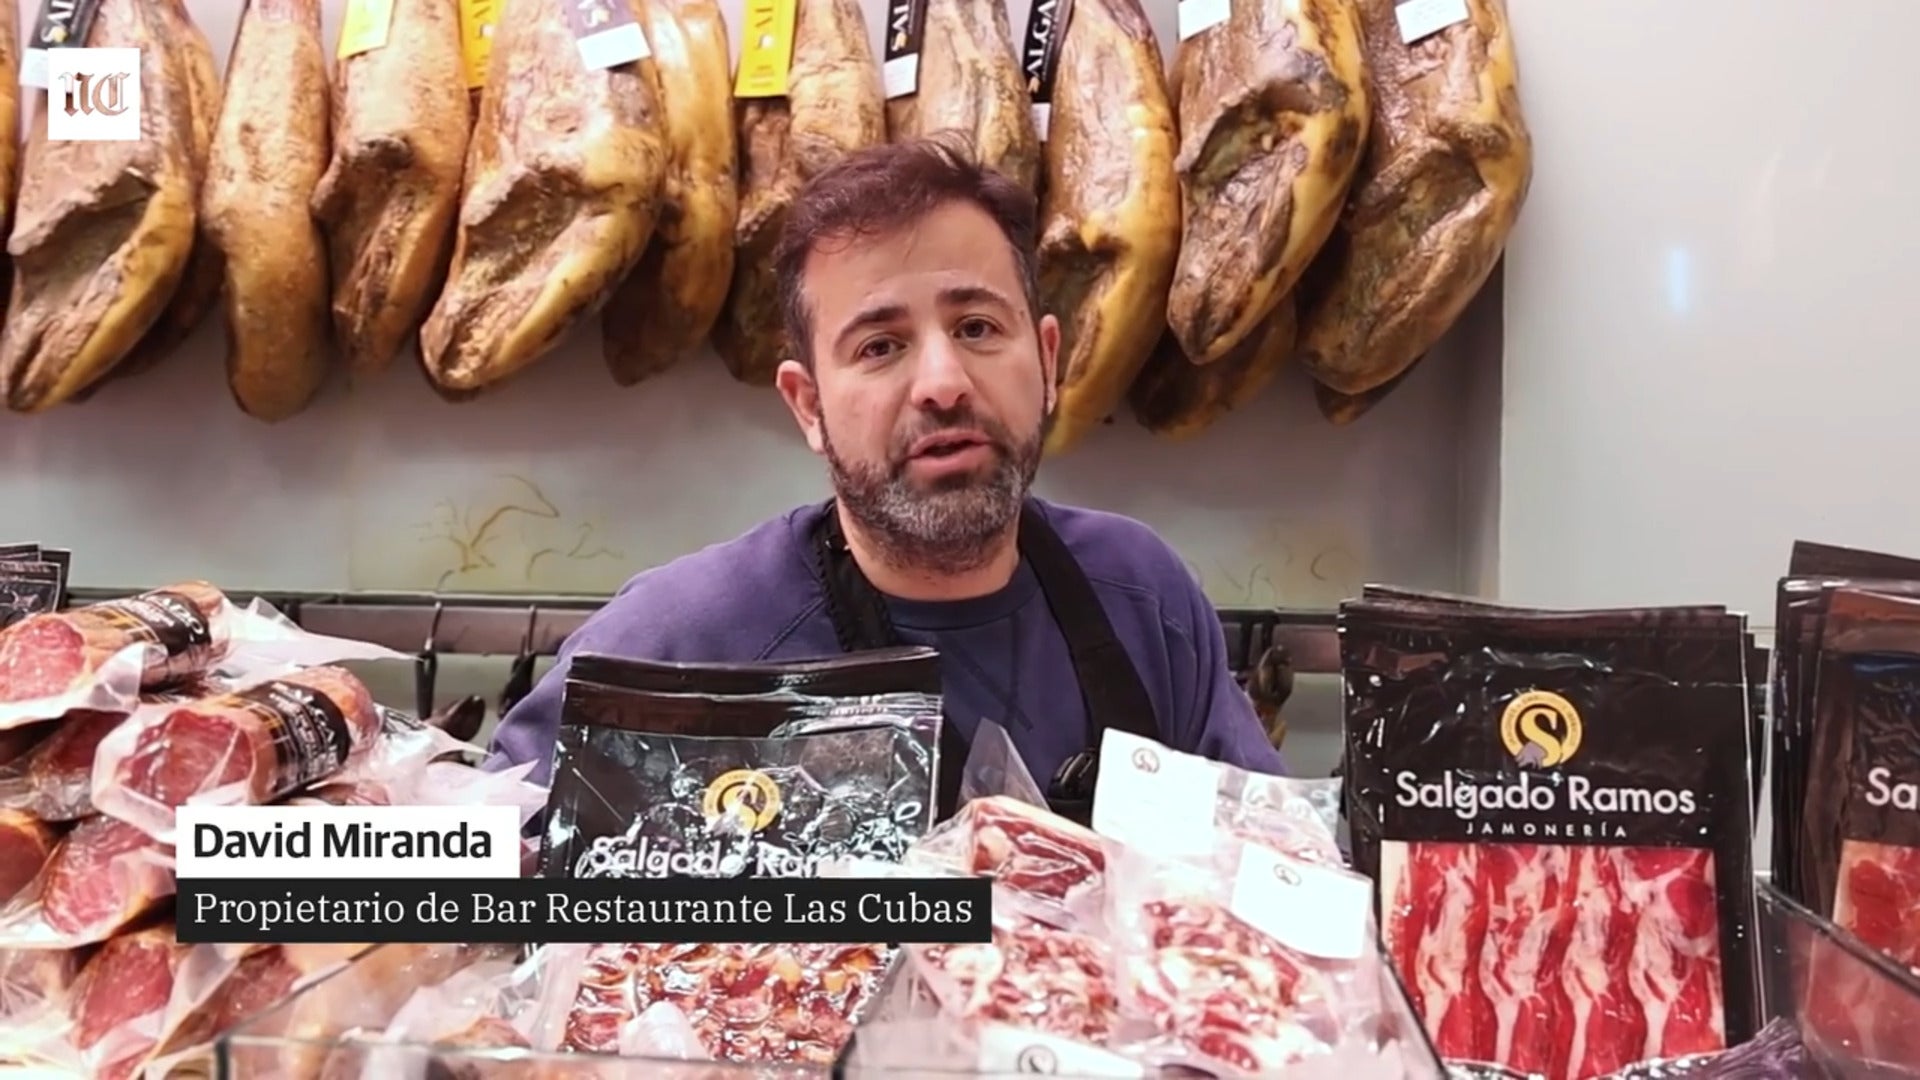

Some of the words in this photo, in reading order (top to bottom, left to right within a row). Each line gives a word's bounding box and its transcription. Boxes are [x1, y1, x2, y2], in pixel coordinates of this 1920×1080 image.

[1396, 771, 1555, 819] Salgado
[1568, 775, 1696, 814] Ramos
[1466, 821, 1627, 838] JAMONERÍA
